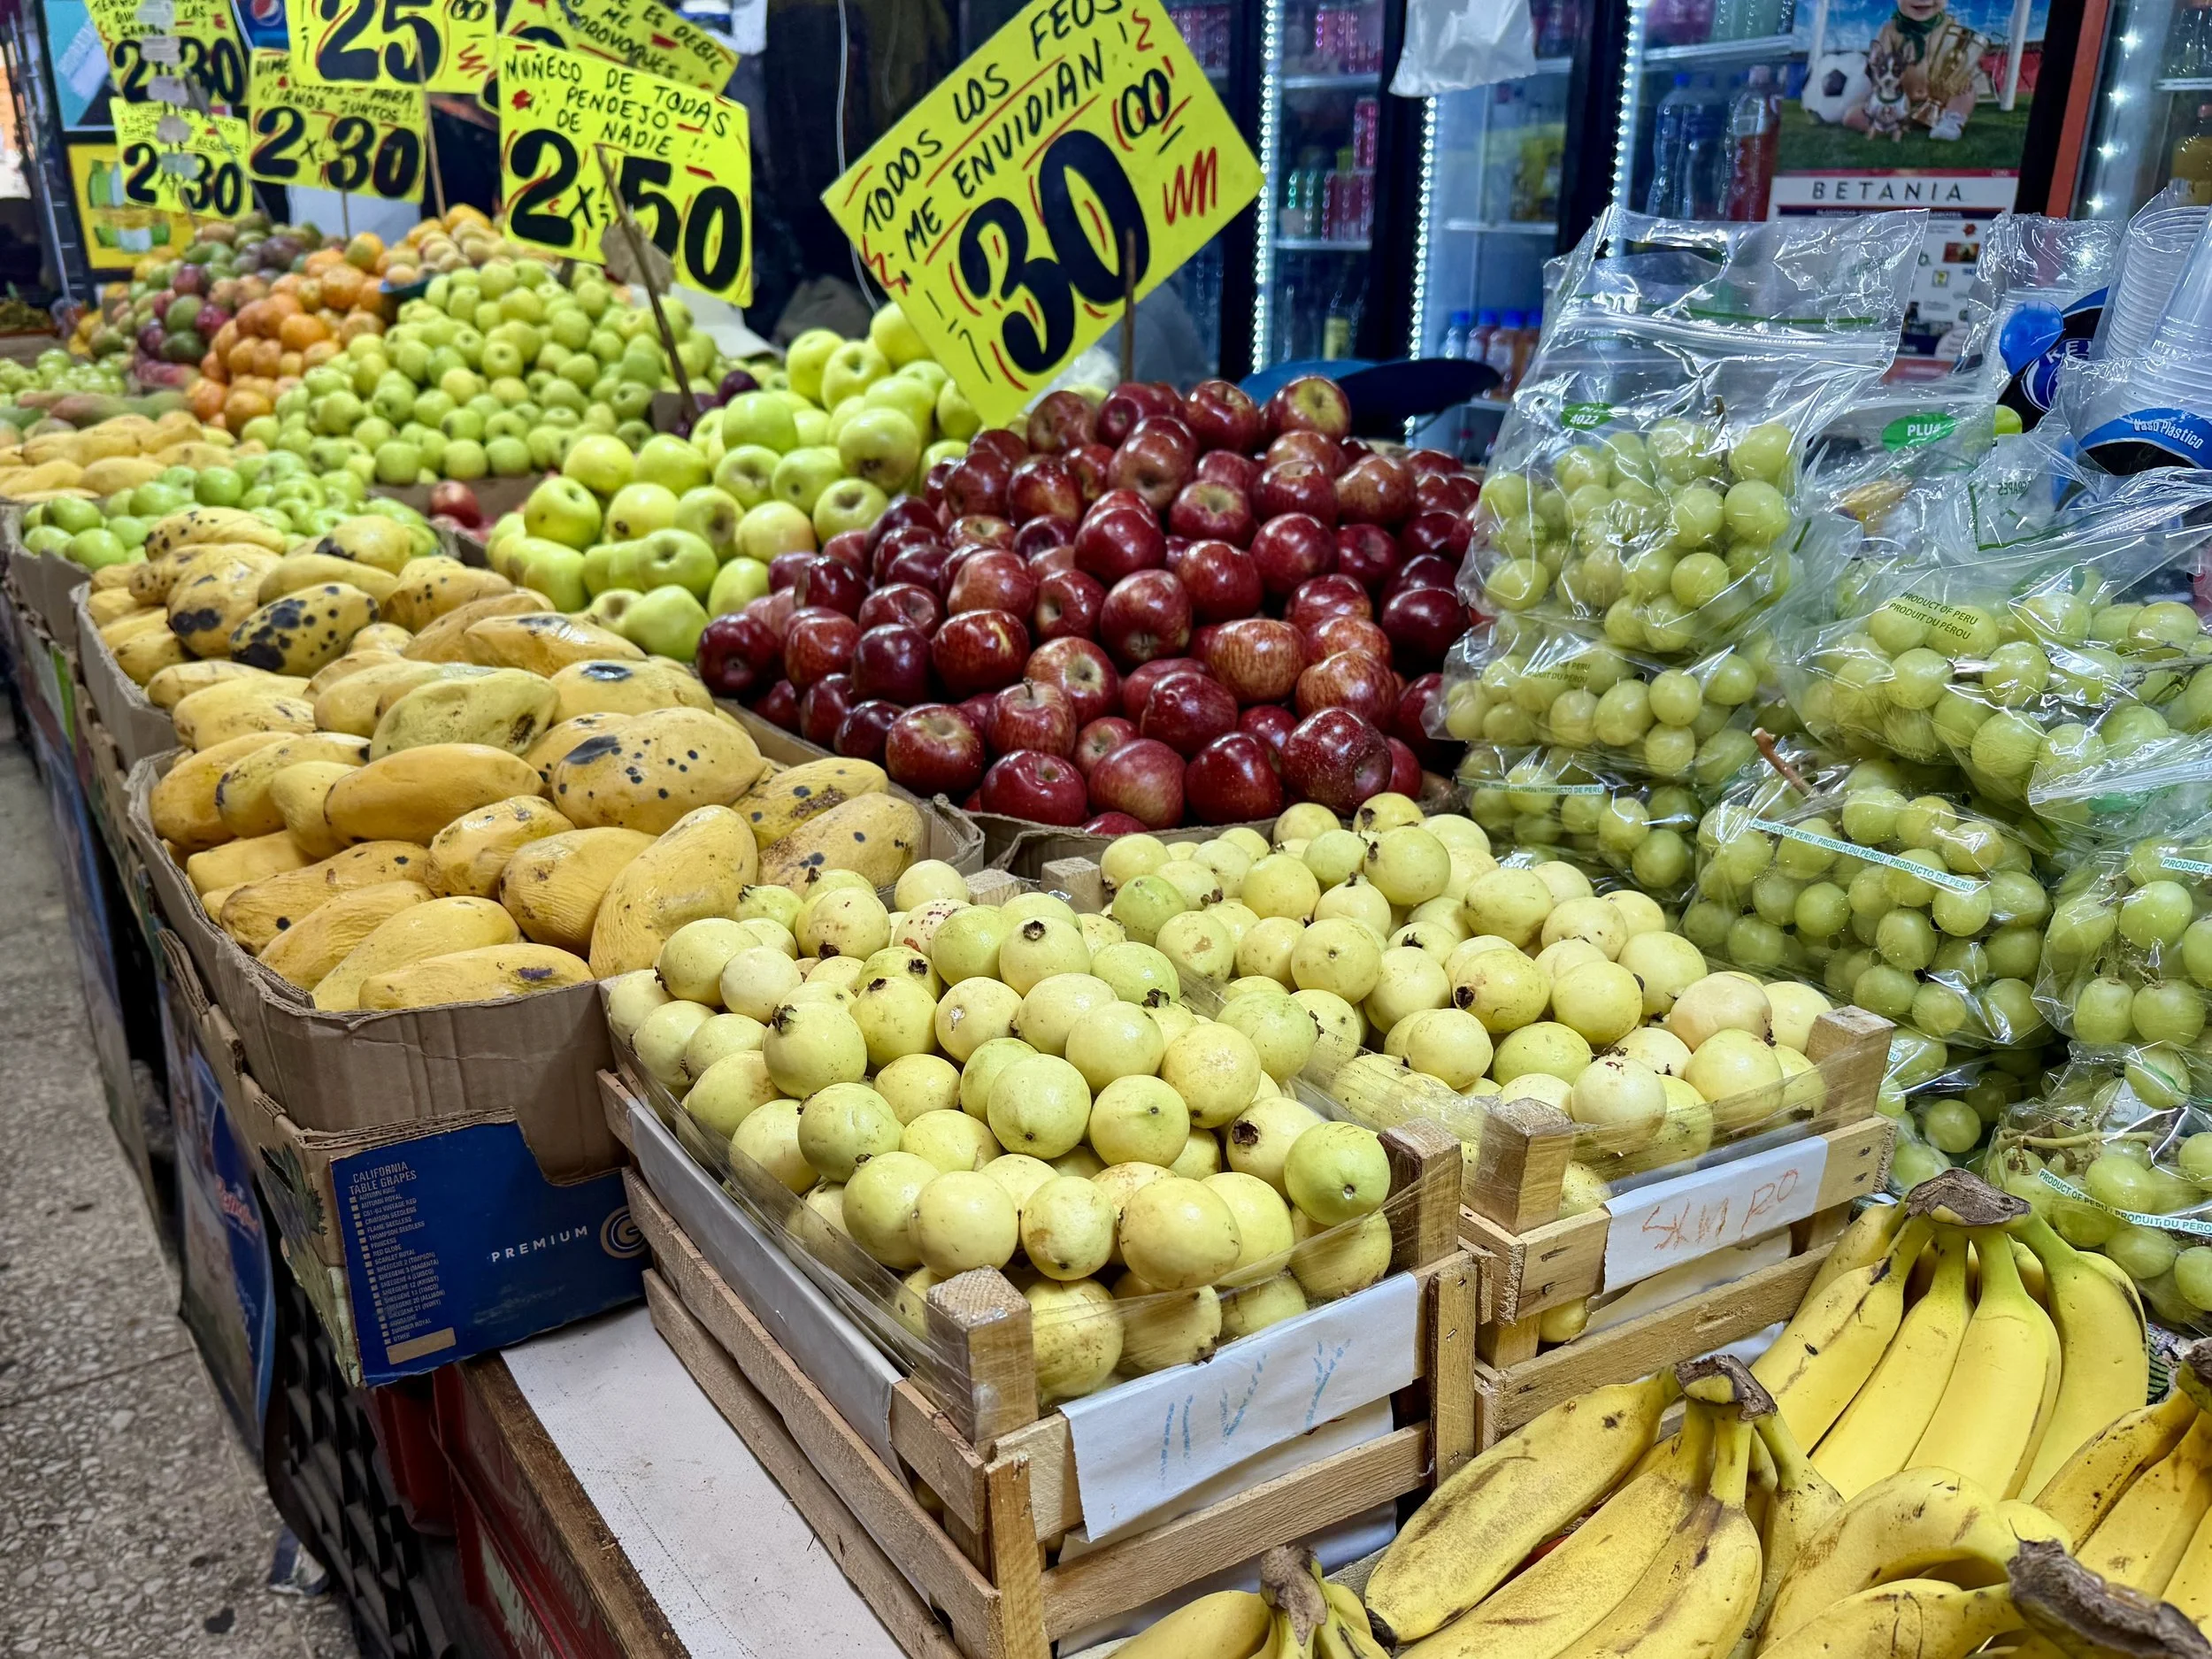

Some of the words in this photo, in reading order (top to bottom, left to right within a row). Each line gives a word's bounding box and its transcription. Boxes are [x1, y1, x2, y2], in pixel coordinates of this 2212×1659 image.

[566, 87, 669, 130] PENDEJO
[605, 68, 634, 95] DE
[653, 84, 731, 137] TODAS
[863, 128, 943, 233] TODOS
[952, 63, 1010, 125] LOS
[1029, 0, 1124, 61] FEOS
[557, 107, 581, 132] DE
[600, 121, 674, 157] NADIE
[1812, 180, 1963, 202] BETANIA
[903, 196, 943, 262] ME
[959, 129, 1150, 375] 30
[1120, 68, 1171, 139] 00
[1570, 414, 1599, 426] 4022
[2160, 419, 2204, 449] Plástico
[1889, 603, 1927, 622] PRODUIT
[1925, 617, 1940, 627] DU
[1939, 622, 1971, 640] PÉROU
[1900, 592, 1941, 611] PRODUCT
[1939, 605, 1954, 615] OF
[1953, 611, 1978, 626] PERU
[1753, 819, 1785, 834] PRODUCT
[1784, 828, 1794, 837] OF
[1794, 831, 1815, 842] PERU
[1817, 837, 1848, 851] PRODUIT
[1848, 847, 1860, 856] DU
[1859, 848, 1886, 862] PÉROU
[1889, 858, 1935, 878] PRODUCTO
[1935, 872, 1948, 882] DE
[2162, 858, 2209, 872] PRODUCT
[349, 1180, 379, 1194] TABLE
[380, 1170, 417, 1187] GRAPES
[353, 1161, 409, 1183] CALIFORNIA
[2039, 1170, 2071, 1194] PRODUCT
[2070, 1188, 2083, 1202] OF
[2084, 1197, 2108, 1211] PERU
[2114, 1210, 2161, 1225] PRODUIT
[2163, 1219, 2179, 1228] DU
[491, 1225, 588, 1263] PREMIUM
